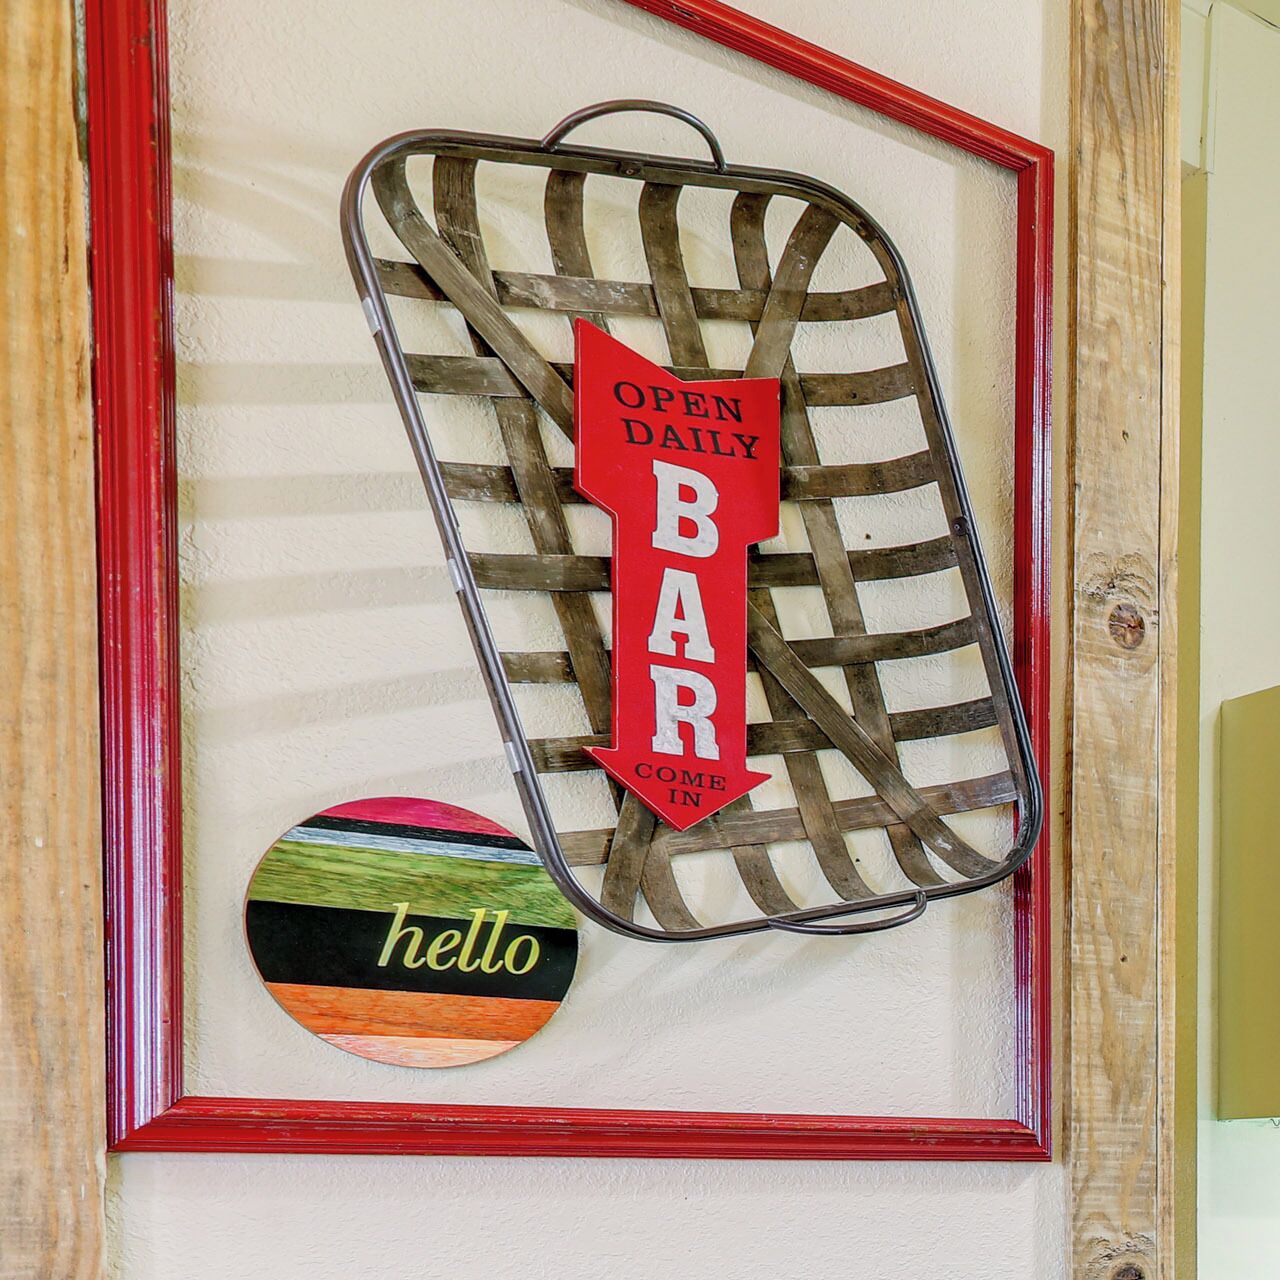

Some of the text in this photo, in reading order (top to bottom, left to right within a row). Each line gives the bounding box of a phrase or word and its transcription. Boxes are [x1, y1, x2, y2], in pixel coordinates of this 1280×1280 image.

[613, 381, 742, 423] OPEN
[620, 417, 760, 460] DAILY
[648, 458, 719, 761] BAR
[634, 763, 727, 791] COME
[668, 788, 702, 808] IN
[377, 901, 541, 975] hello
